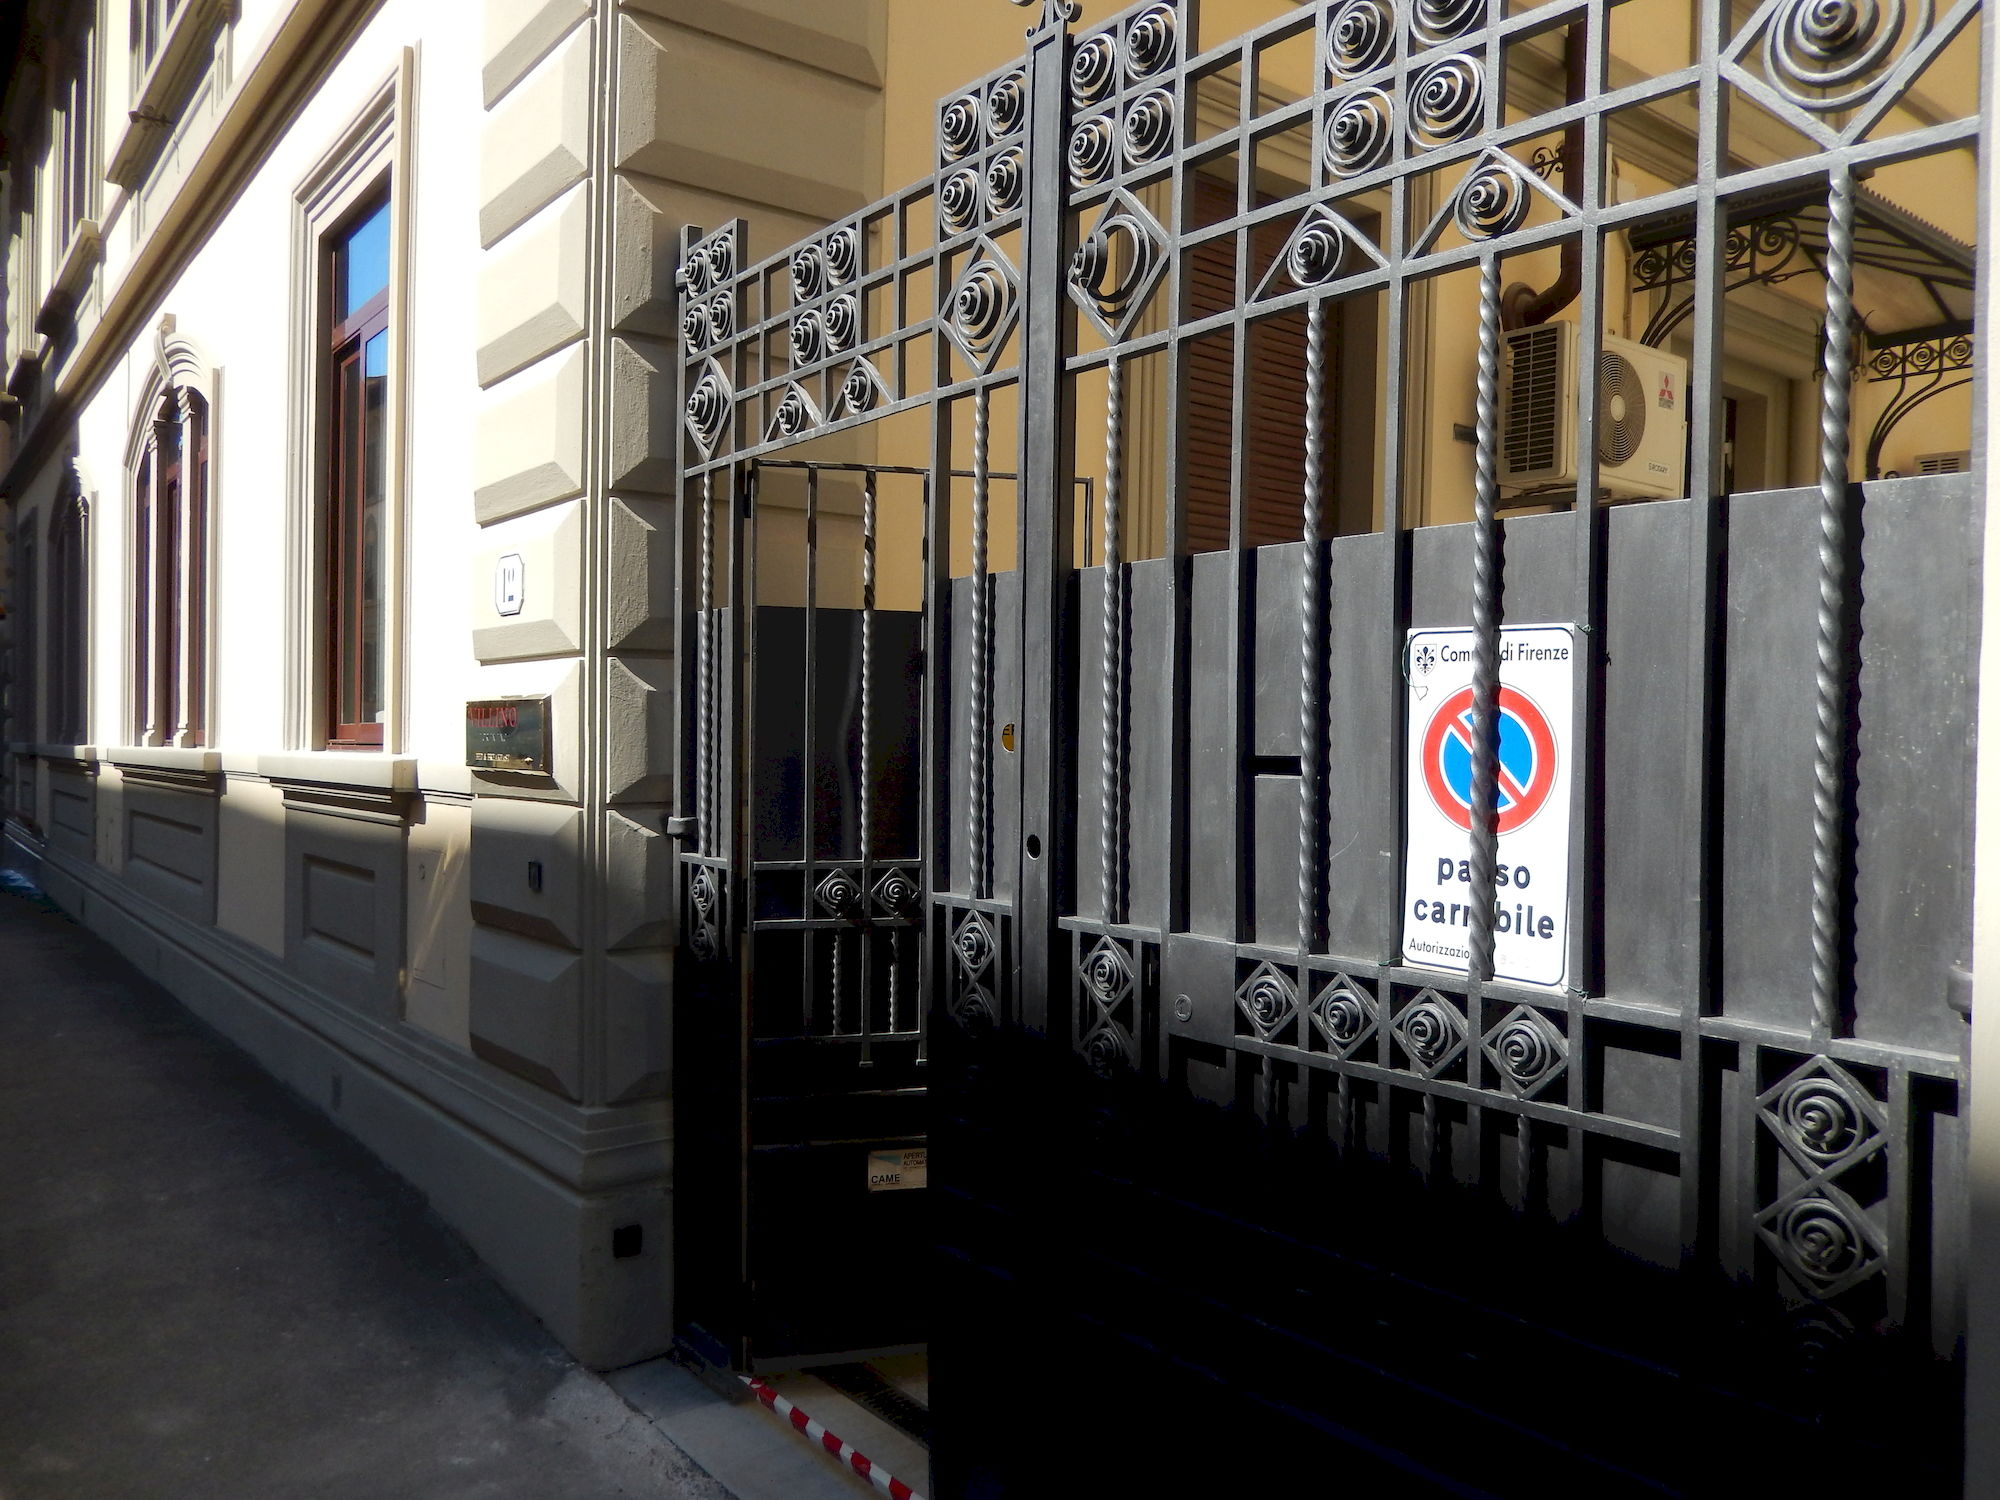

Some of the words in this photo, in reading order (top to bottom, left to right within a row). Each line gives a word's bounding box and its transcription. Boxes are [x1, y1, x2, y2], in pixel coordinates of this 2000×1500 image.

[1440, 645, 1476, 662] Com
[1501, 641, 1513, 661] di
[1518, 643, 1569, 661] Firenze
[468, 707, 517, 728] VILLINO
[1437, 857, 1530, 889] paso
[1413, 899, 1554, 940] carrbile
[871, 1174, 900, 1184] CAME
